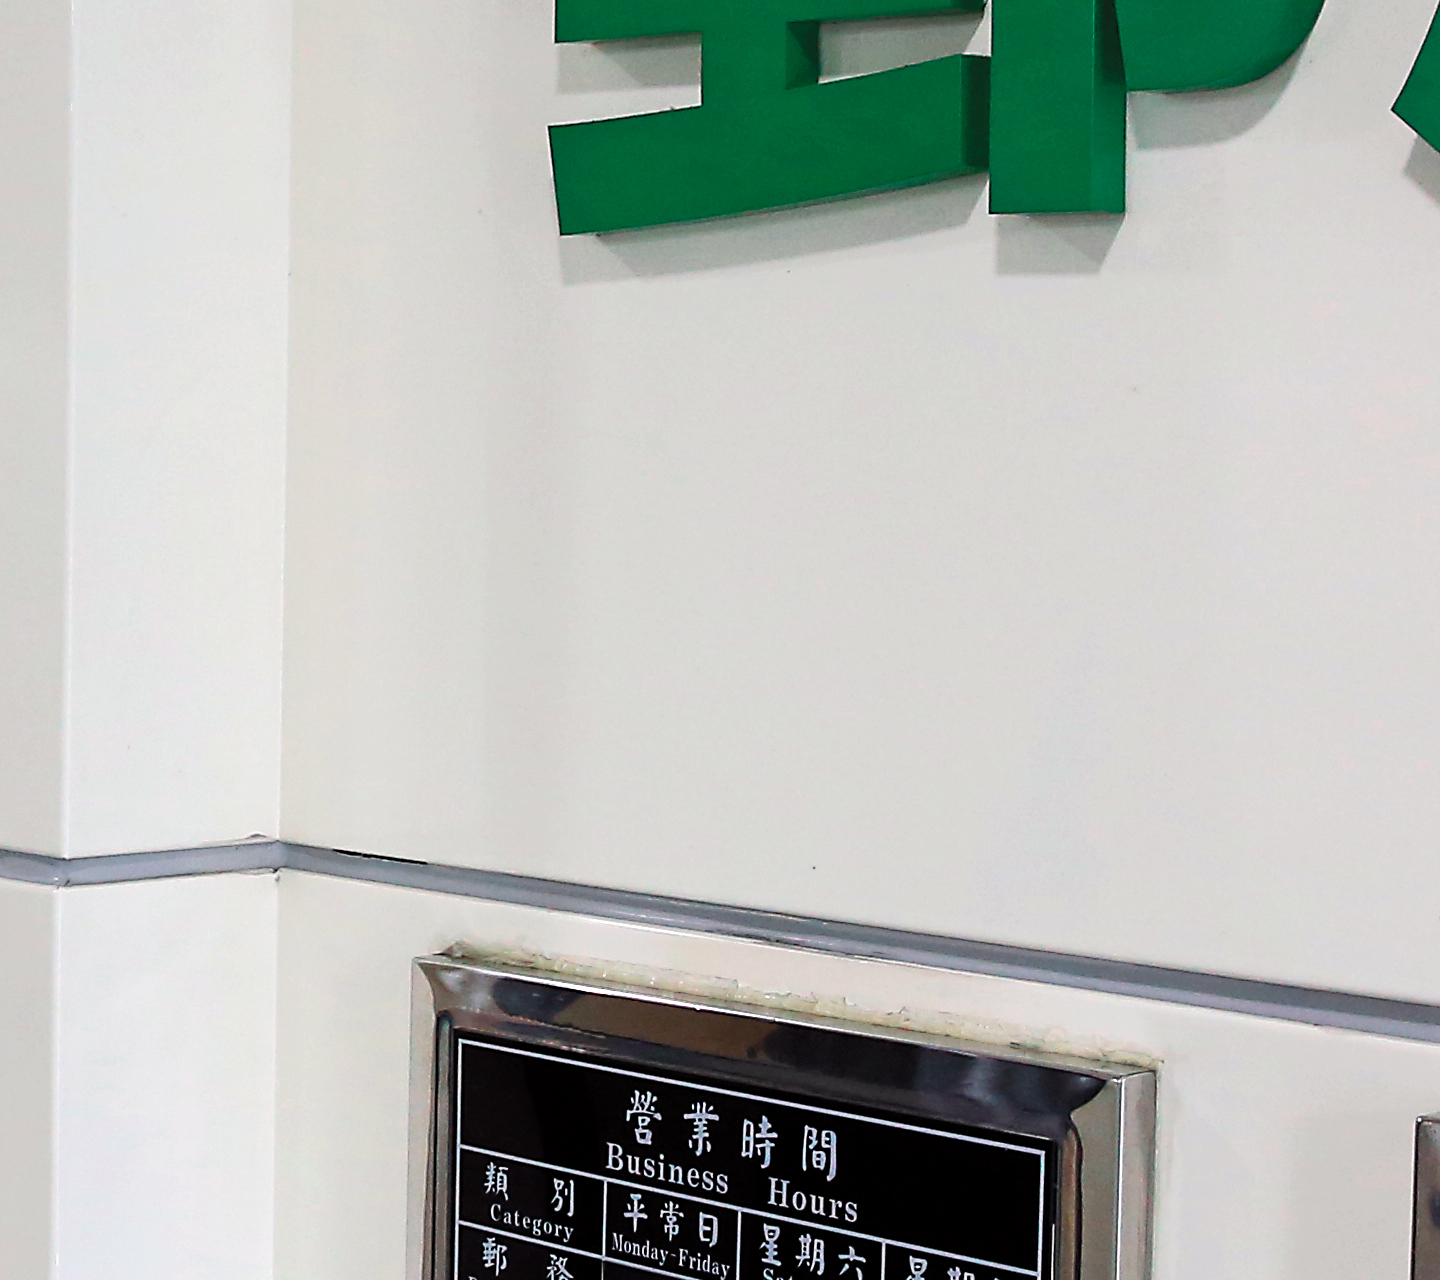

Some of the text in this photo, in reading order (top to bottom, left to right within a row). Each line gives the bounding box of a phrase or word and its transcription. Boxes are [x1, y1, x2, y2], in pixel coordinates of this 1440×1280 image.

[626, 1090, 836, 1181] 營業時間
[484, 1162, 574, 1216] 類別
[606, 1142, 857, 1222] Business Hours
[491, 1204, 573, 1242] Category
[624, 1194, 718, 1247] 平常日
[613, 1233, 730, 1280] Monday-Friday
[760, 1223, 866, 1280] 星期六
